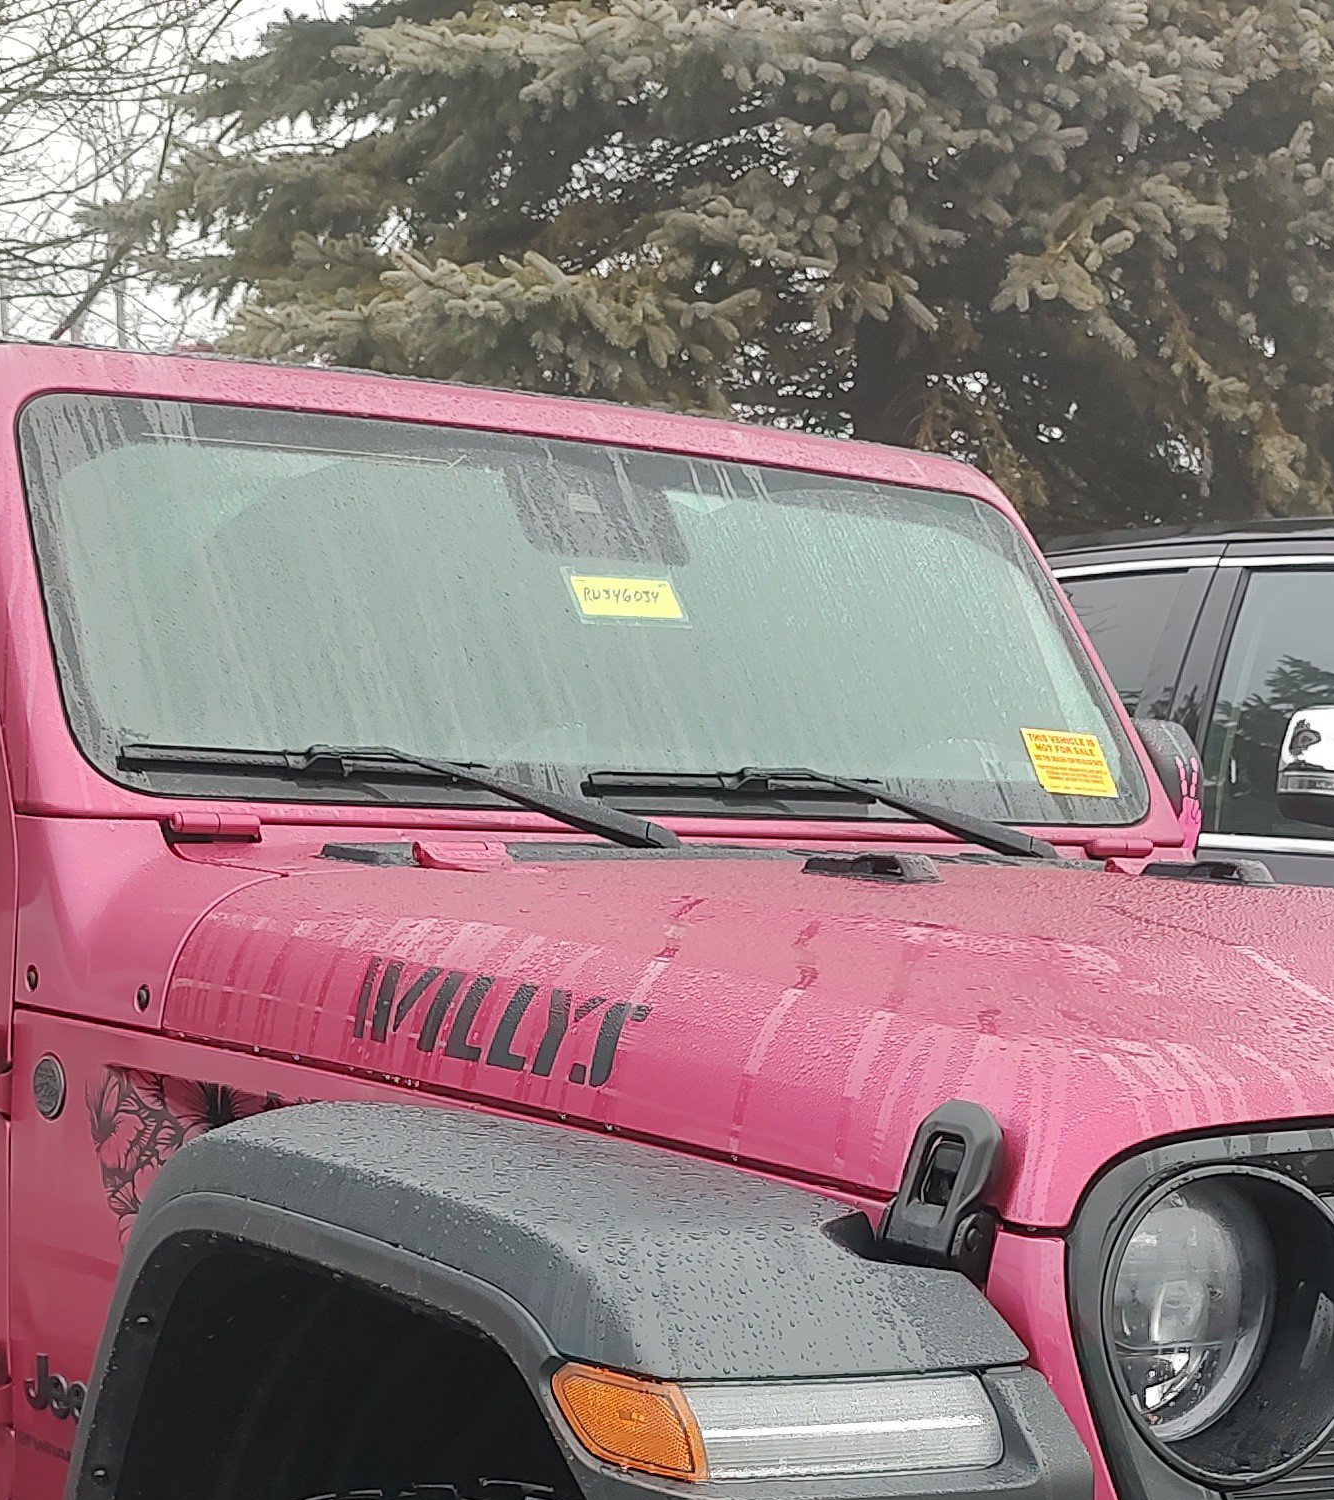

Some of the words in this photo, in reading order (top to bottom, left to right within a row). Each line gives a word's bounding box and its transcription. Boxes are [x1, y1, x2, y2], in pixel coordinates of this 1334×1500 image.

[1027, 733, 1048, 743] THIS
[1049, 735, 1086, 746] VEHICLE
[1087, 738, 1096, 747] IS
[1034, 743, 1054, 753] NOT
[1055, 745, 1072, 755] FOR
[1073, 747, 1096, 757] SALE
[24, 1352, 88, 1422] Jee
